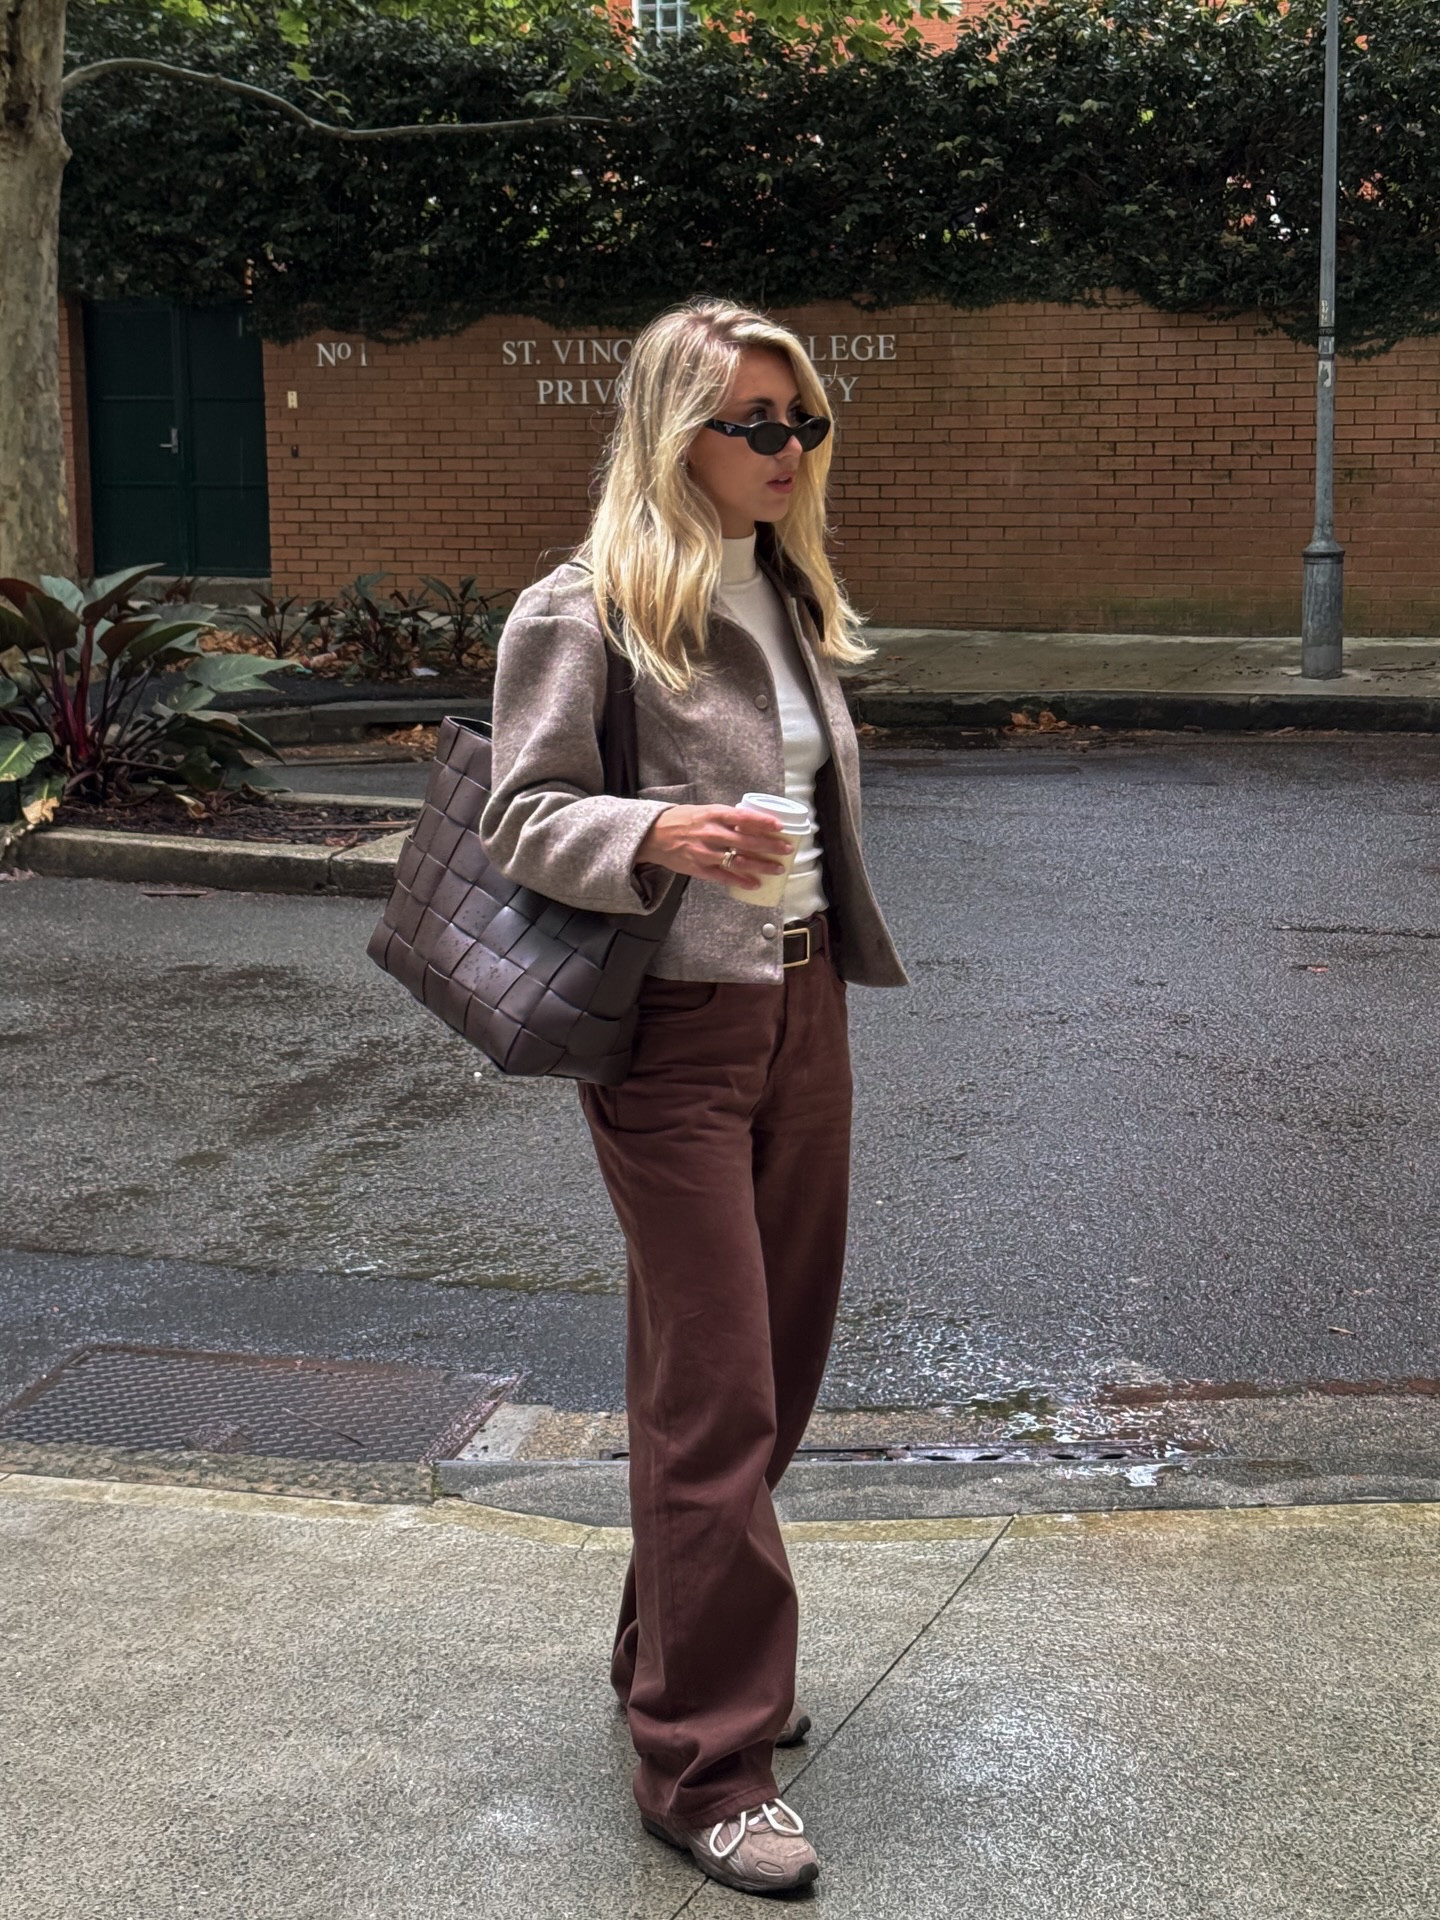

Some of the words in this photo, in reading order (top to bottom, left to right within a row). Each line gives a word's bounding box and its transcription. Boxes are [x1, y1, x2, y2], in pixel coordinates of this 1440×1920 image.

[502, 340, 541, 366] ST.
[552, 338, 633, 365] VINC
[807, 334, 897, 361] LEGE
[536, 379, 618, 405] PRIV
